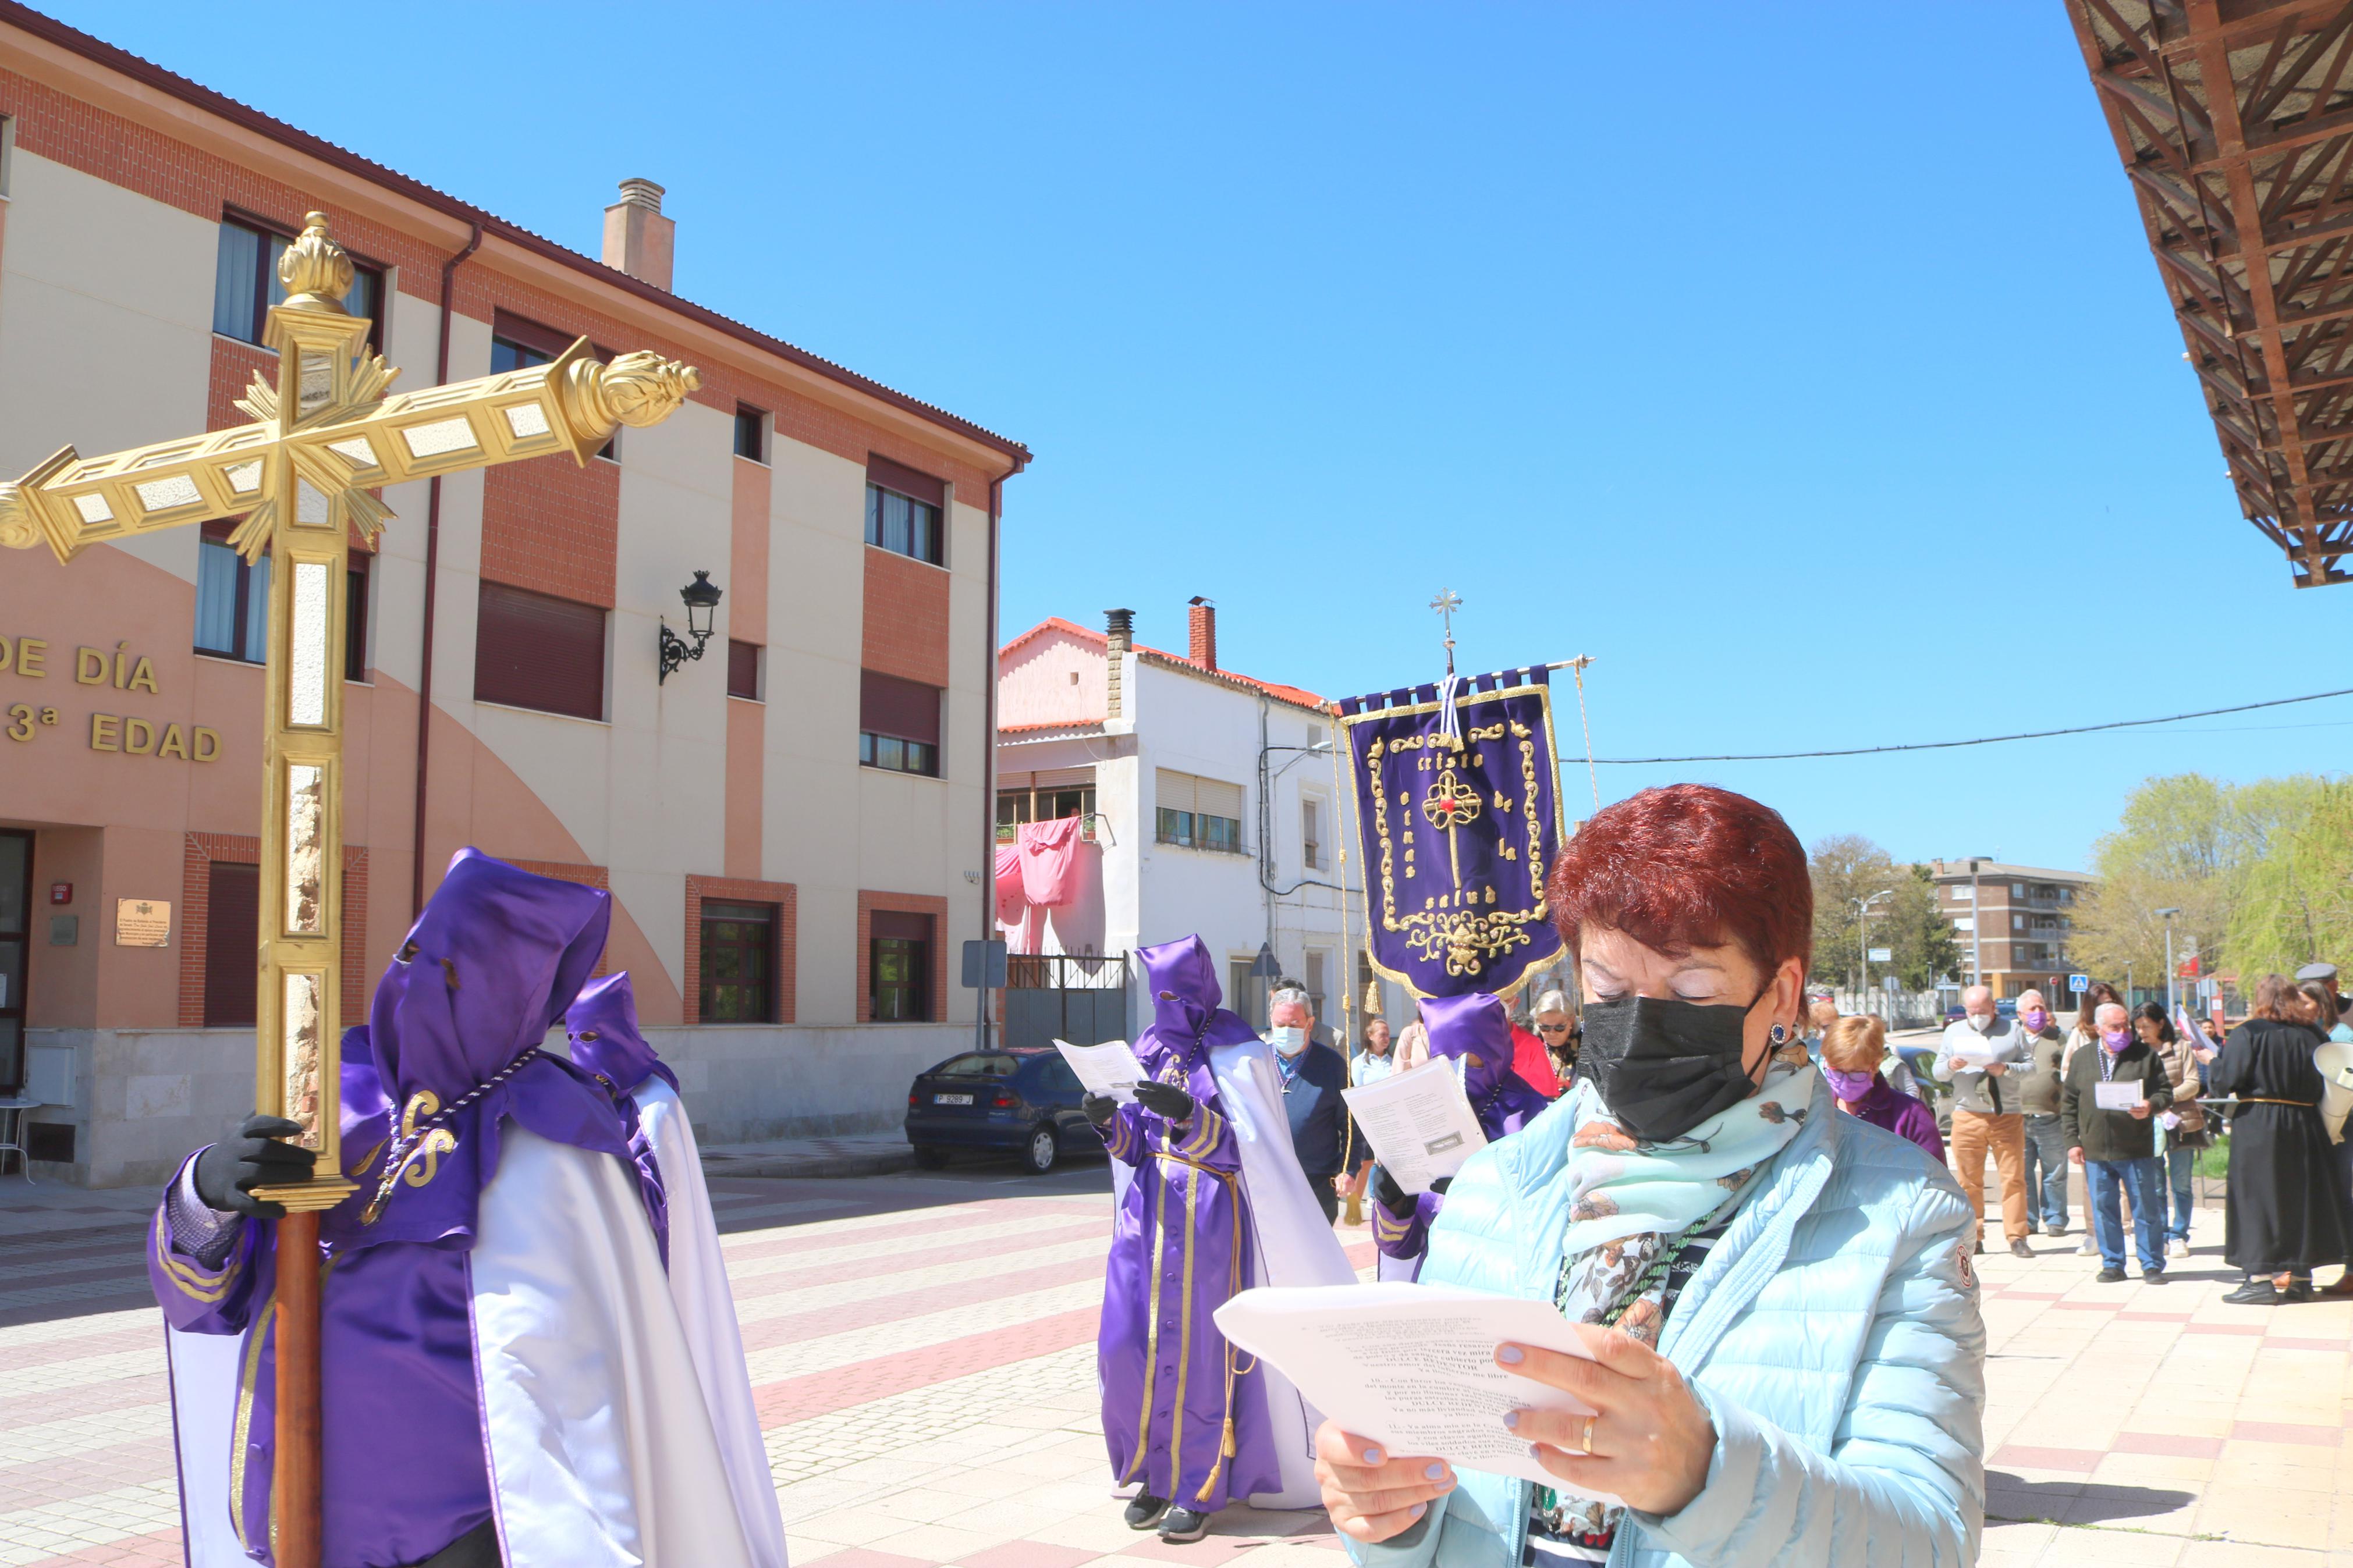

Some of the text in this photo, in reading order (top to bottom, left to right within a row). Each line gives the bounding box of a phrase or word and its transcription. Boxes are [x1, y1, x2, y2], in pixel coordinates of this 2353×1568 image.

[76, 641, 159, 694] DÍA
[6, 703, 222, 762] 3ª EDAD
[946, 1095, 963, 1103] 9289
